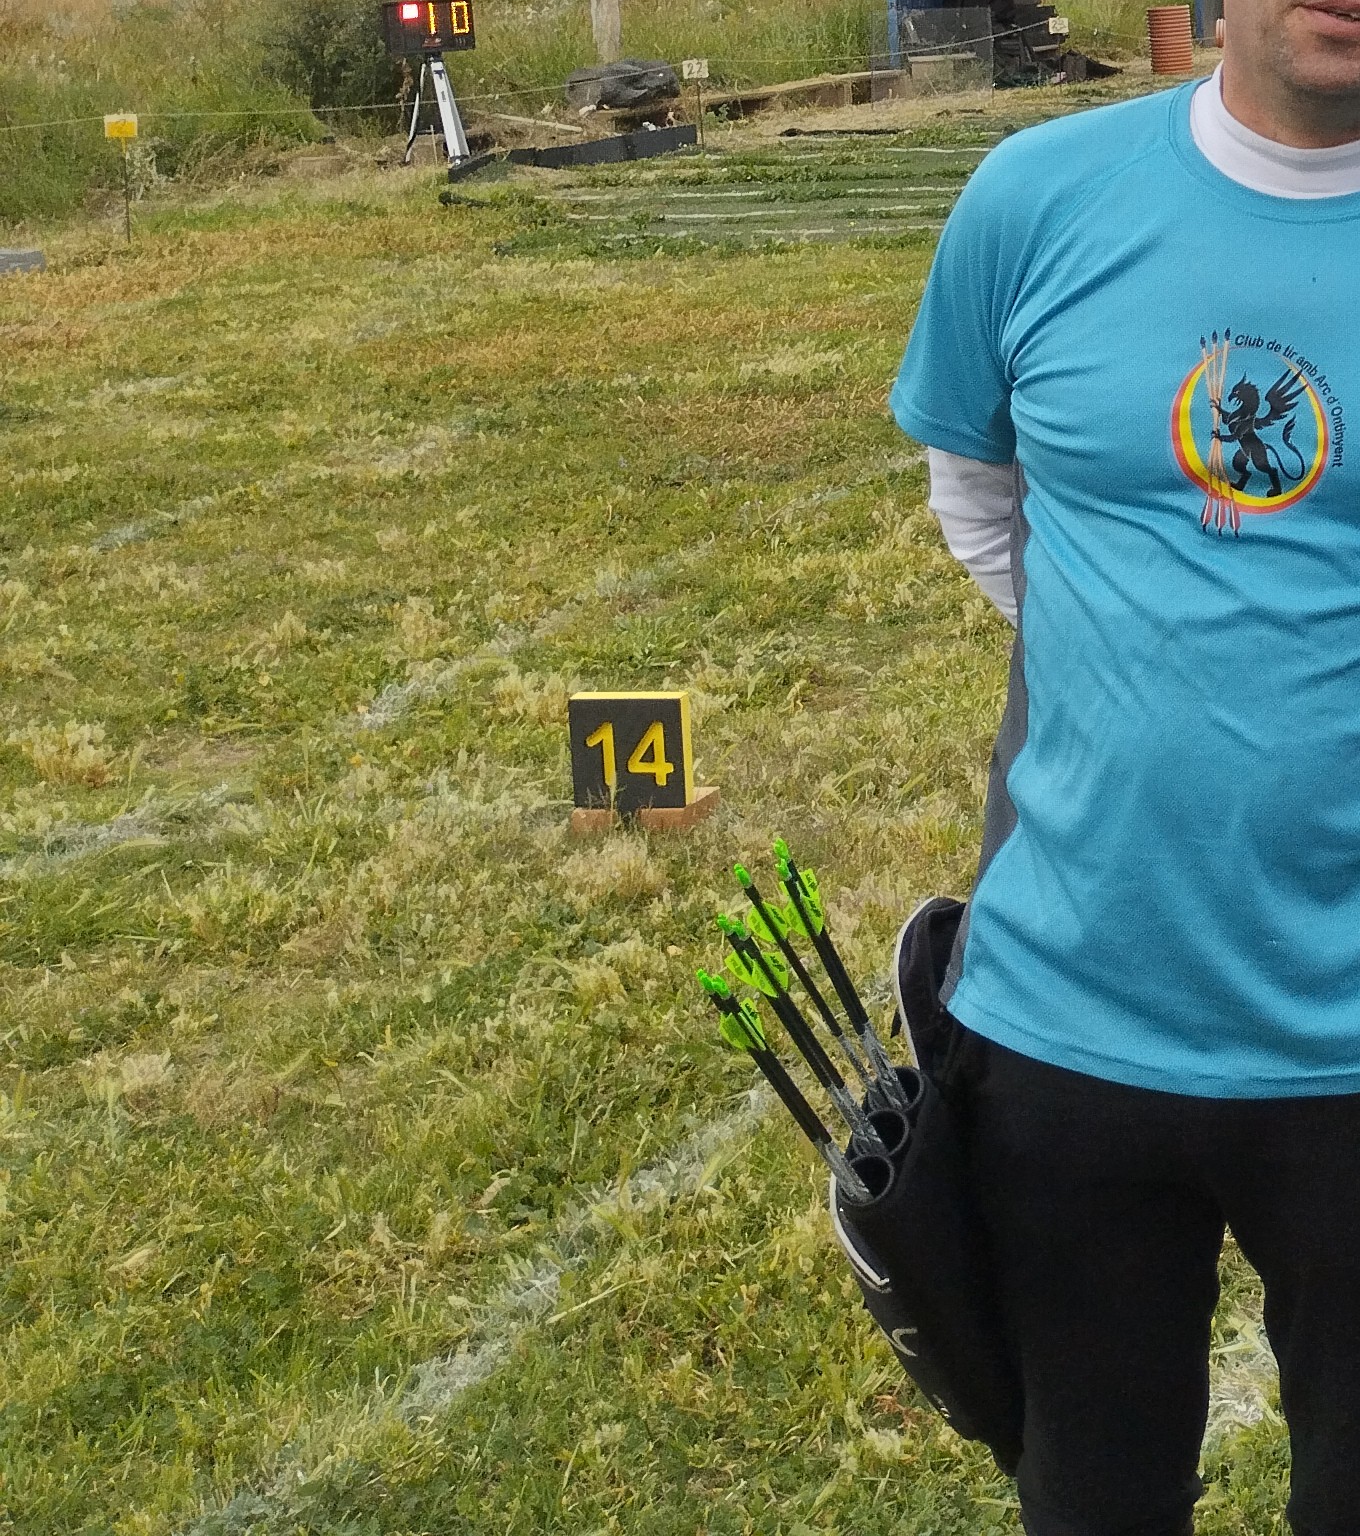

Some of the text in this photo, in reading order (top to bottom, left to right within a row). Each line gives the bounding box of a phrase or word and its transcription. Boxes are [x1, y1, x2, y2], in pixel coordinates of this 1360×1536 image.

[1234, 334, 1265, 348] Club
[1266, 339, 1282, 352] de
[1283, 343, 1298, 360] tir
[1296, 356, 1318, 377] amb
[1314, 375, 1332, 396] Arc
[585, 720, 675, 787] 14
